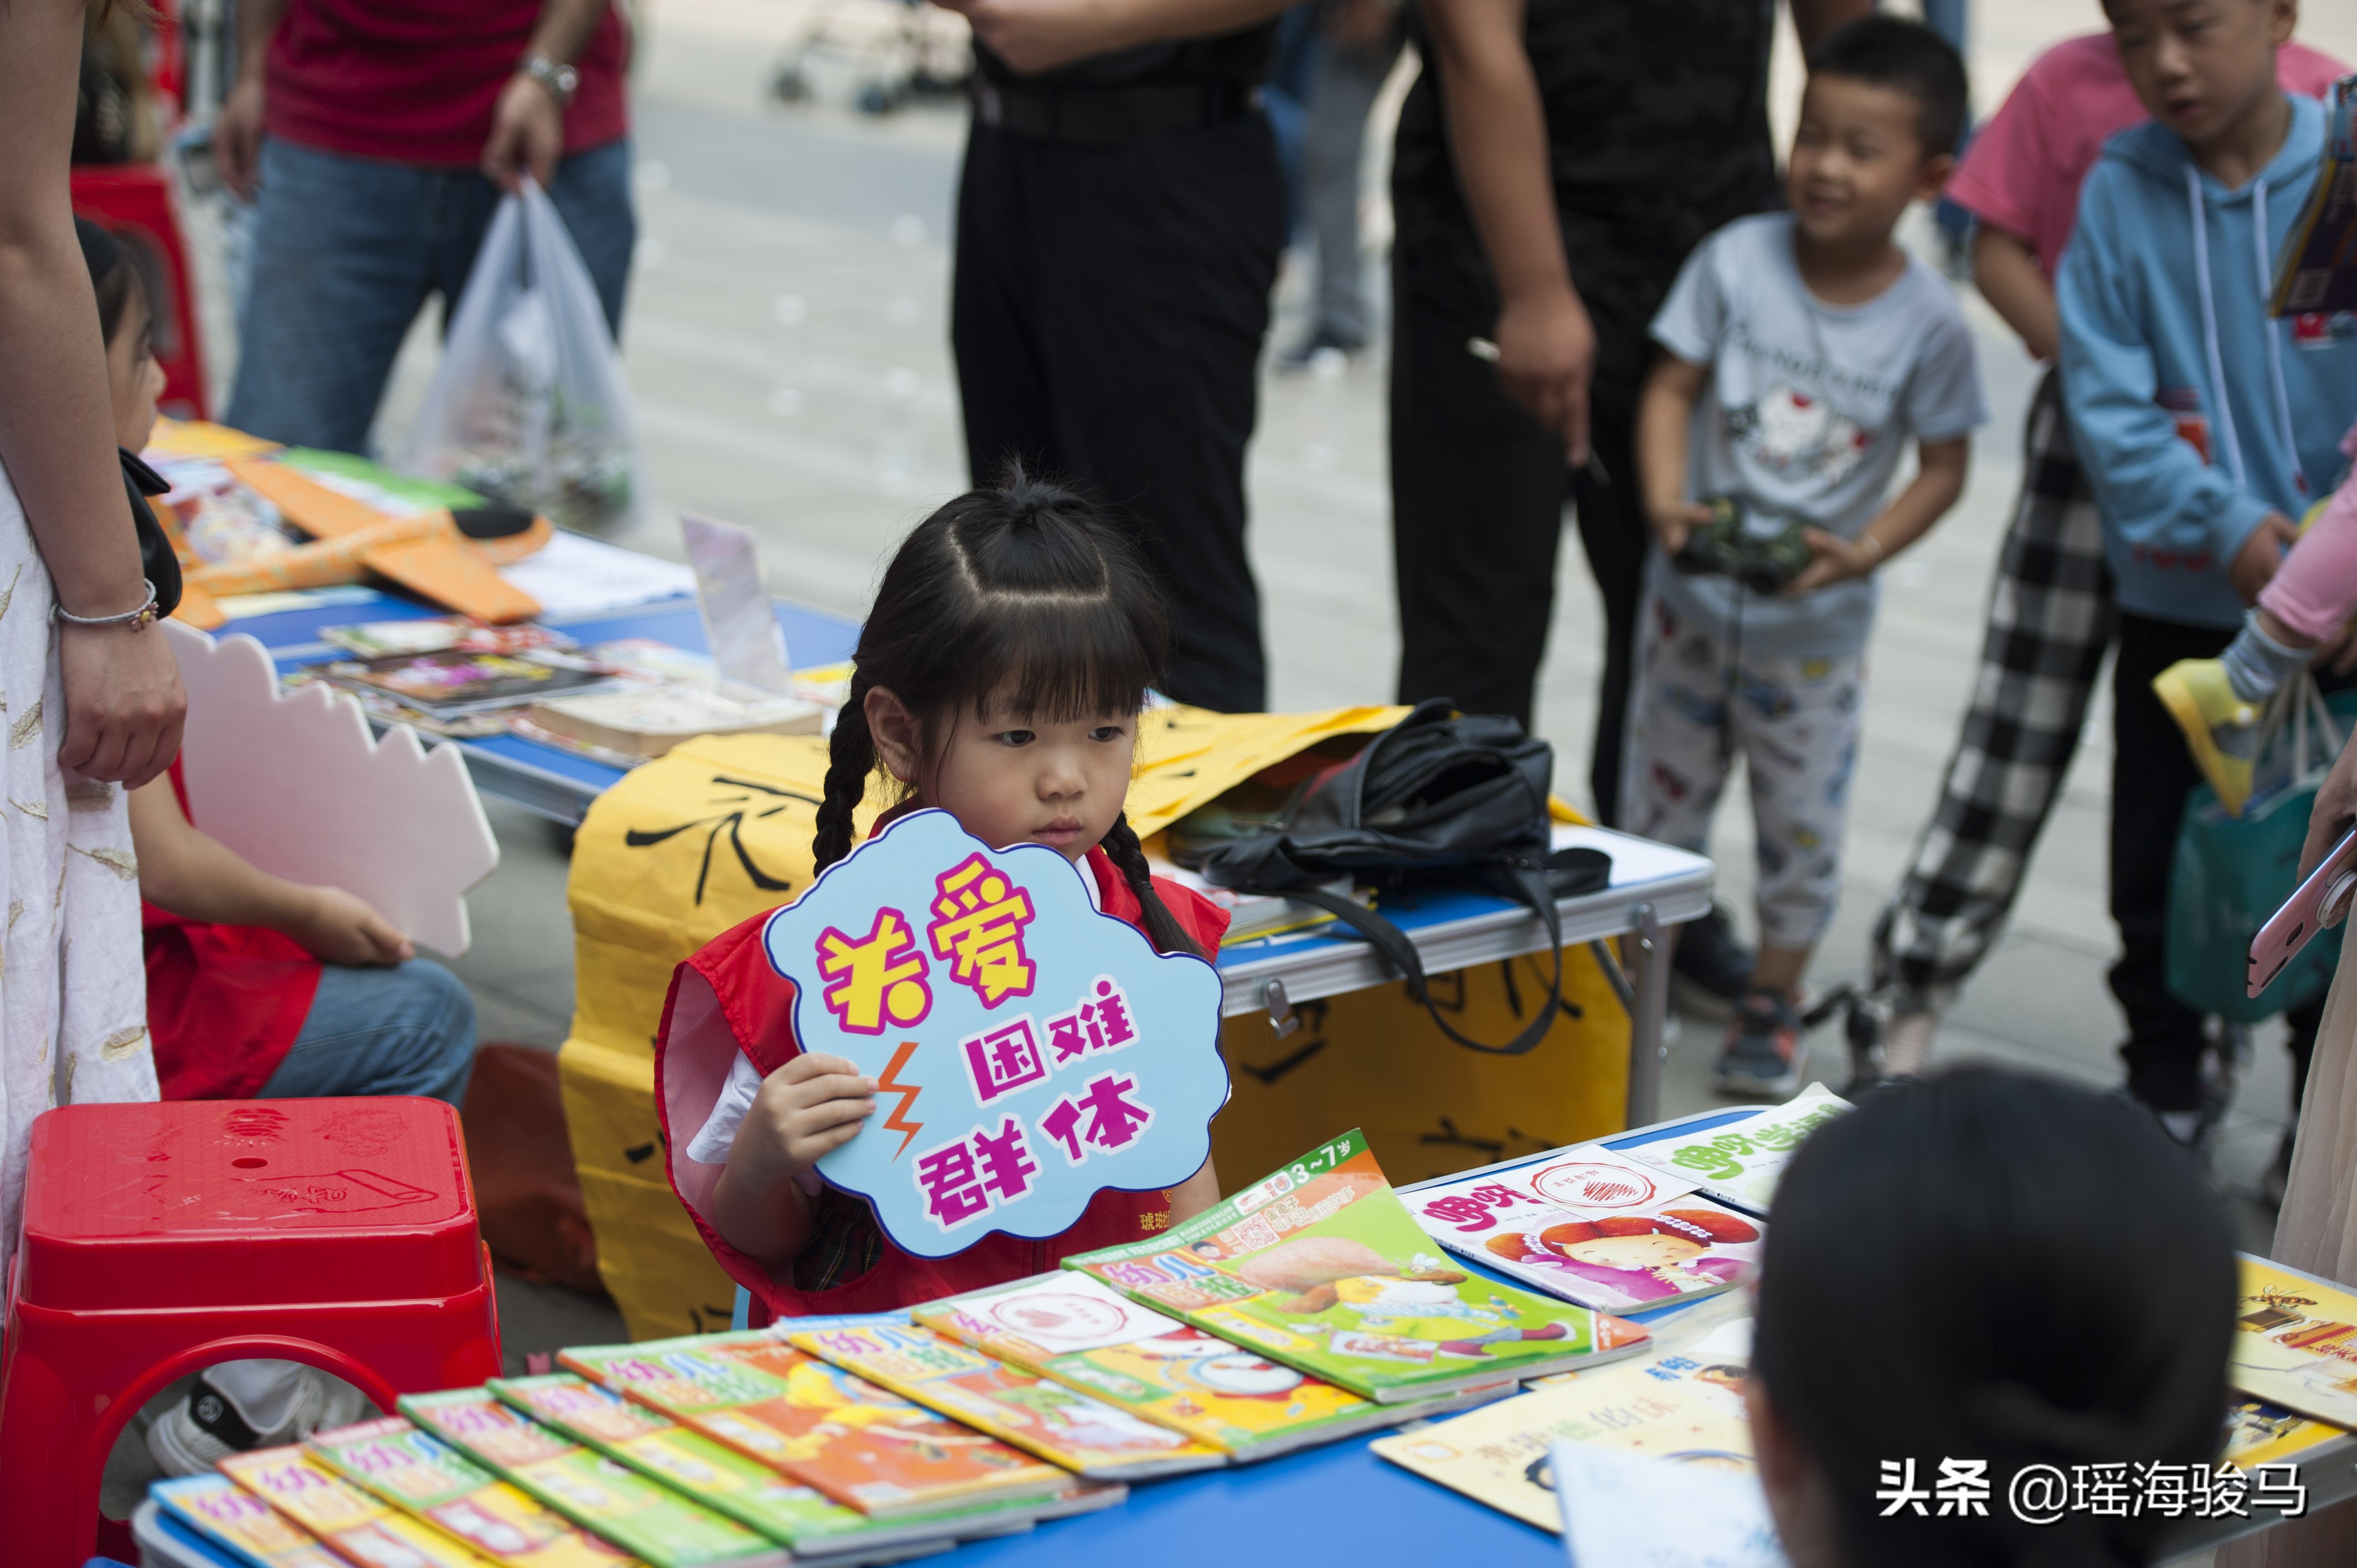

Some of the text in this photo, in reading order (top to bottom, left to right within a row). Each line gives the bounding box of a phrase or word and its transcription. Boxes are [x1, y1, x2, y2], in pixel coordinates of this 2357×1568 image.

[815, 852, 1036, 1036] 关爱
[965, 979, 1135, 1102] 困难
[918, 1075, 1150, 1226] 群体
